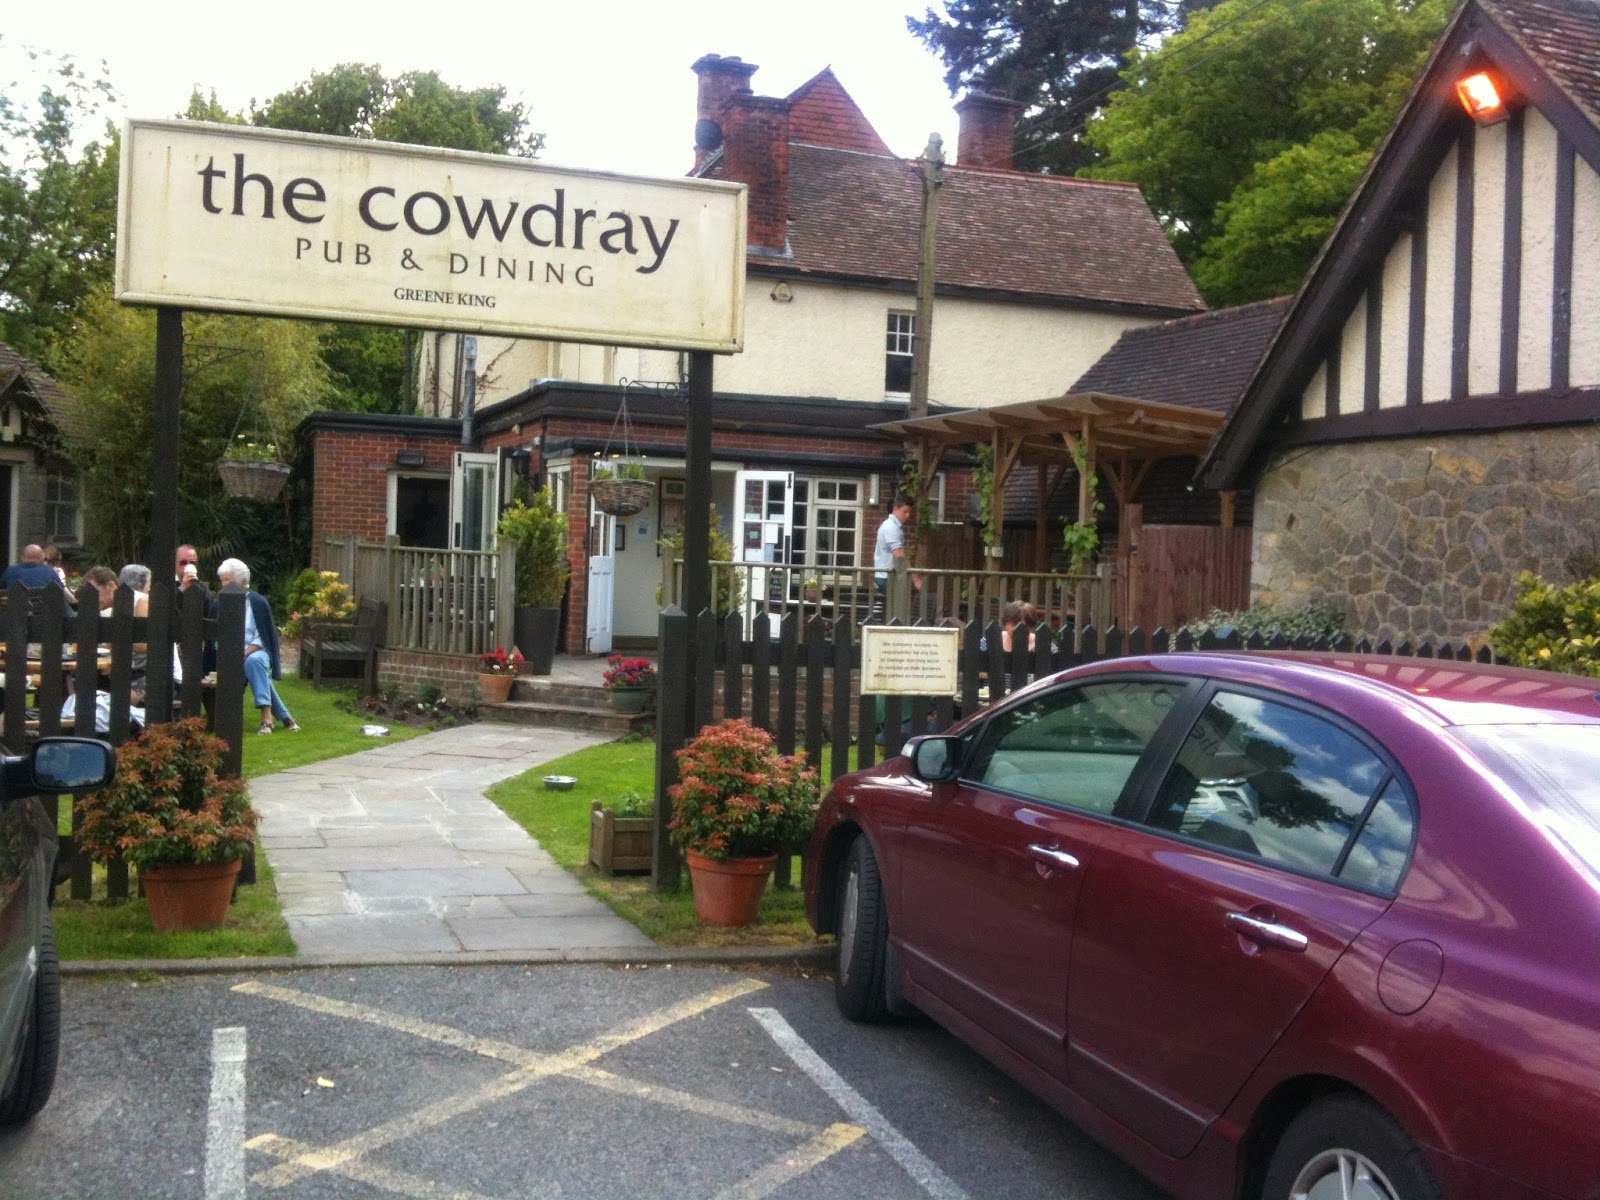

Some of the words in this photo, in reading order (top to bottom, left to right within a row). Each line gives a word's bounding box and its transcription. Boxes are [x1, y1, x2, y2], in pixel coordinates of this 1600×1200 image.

[197, 153, 326, 224] the
[358, 186, 680, 274] cowdray
[295, 237, 372, 265] PUB
[399, 247, 424, 271] &
[449, 252, 594, 287] DINING
[394, 287, 454, 304] GREENE
[457, 293, 496, 308] KING
